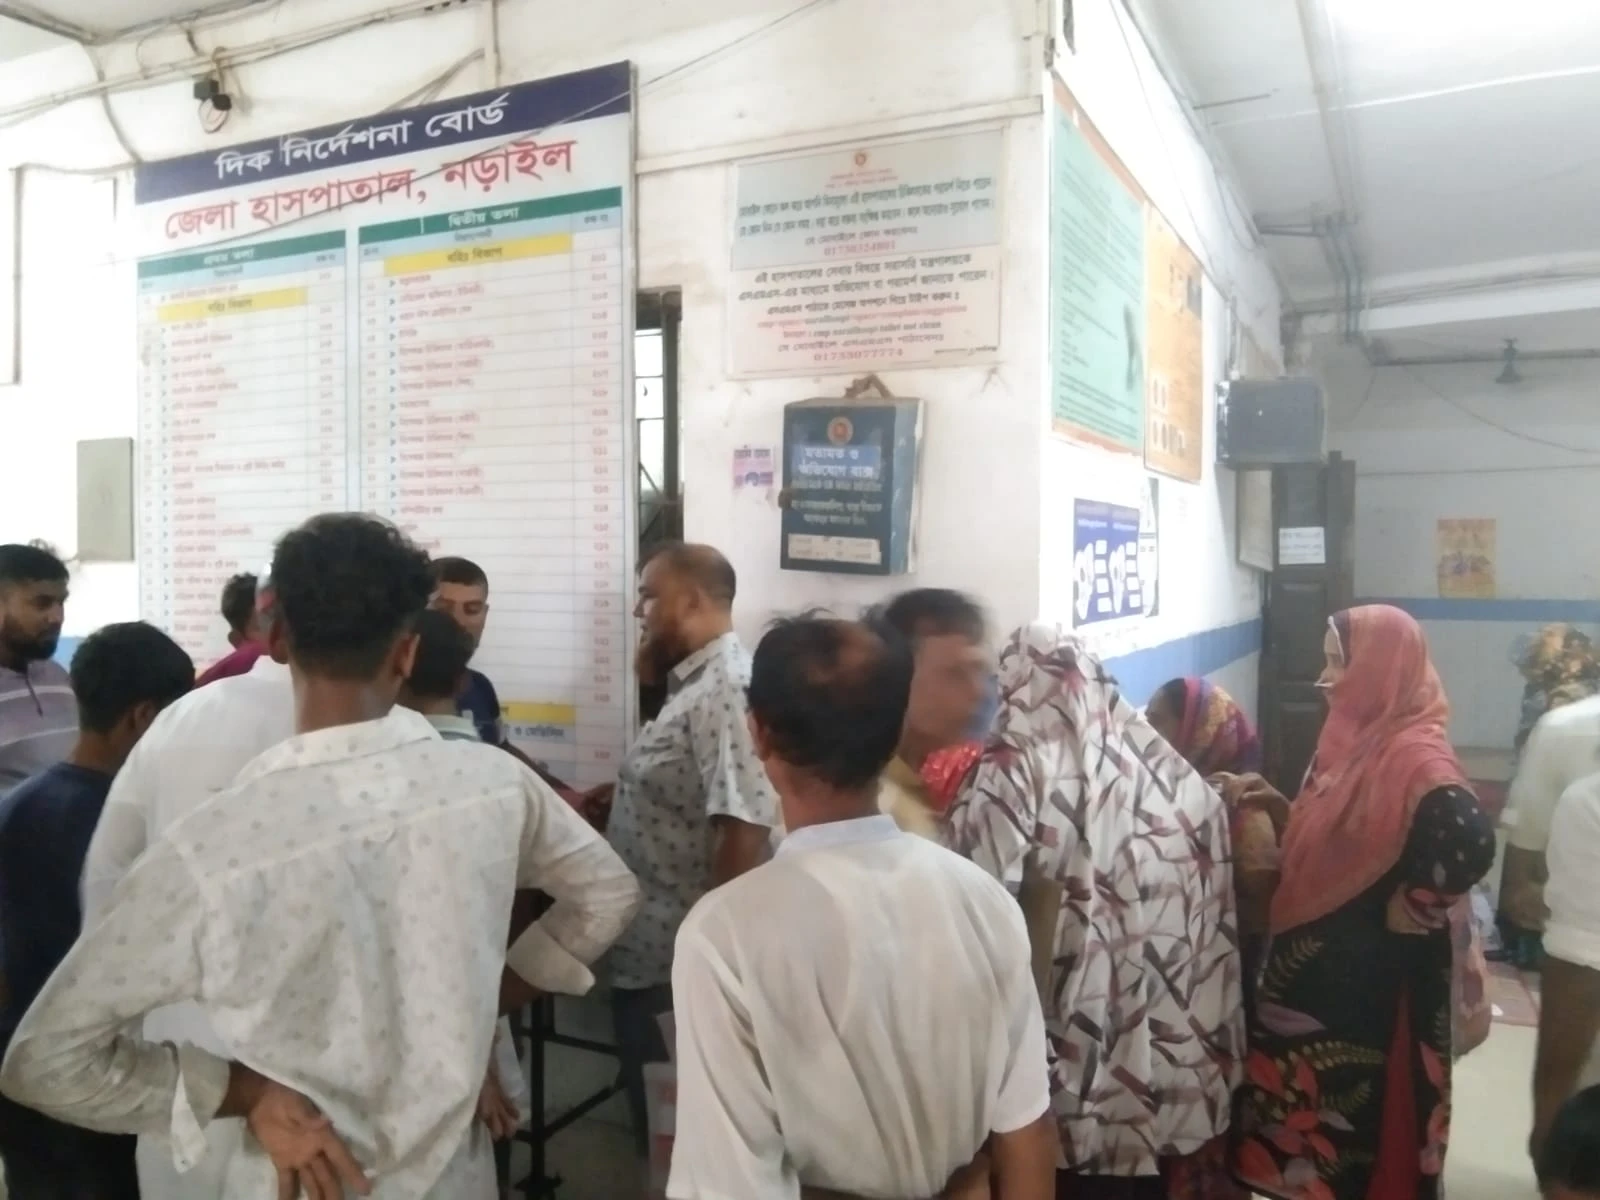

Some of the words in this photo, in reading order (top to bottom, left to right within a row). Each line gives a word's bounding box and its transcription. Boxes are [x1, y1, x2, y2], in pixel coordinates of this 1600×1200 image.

[215, 148, 273, 180] দিক
[281, 119, 412, 167] নির্দেশনা
[425, 93, 511, 138] বোর্ড
[165, 200, 239, 240] জেলা
[249, 167, 428, 225] হাসপাতাল,
[442, 139, 579, 194] নড়াইল
